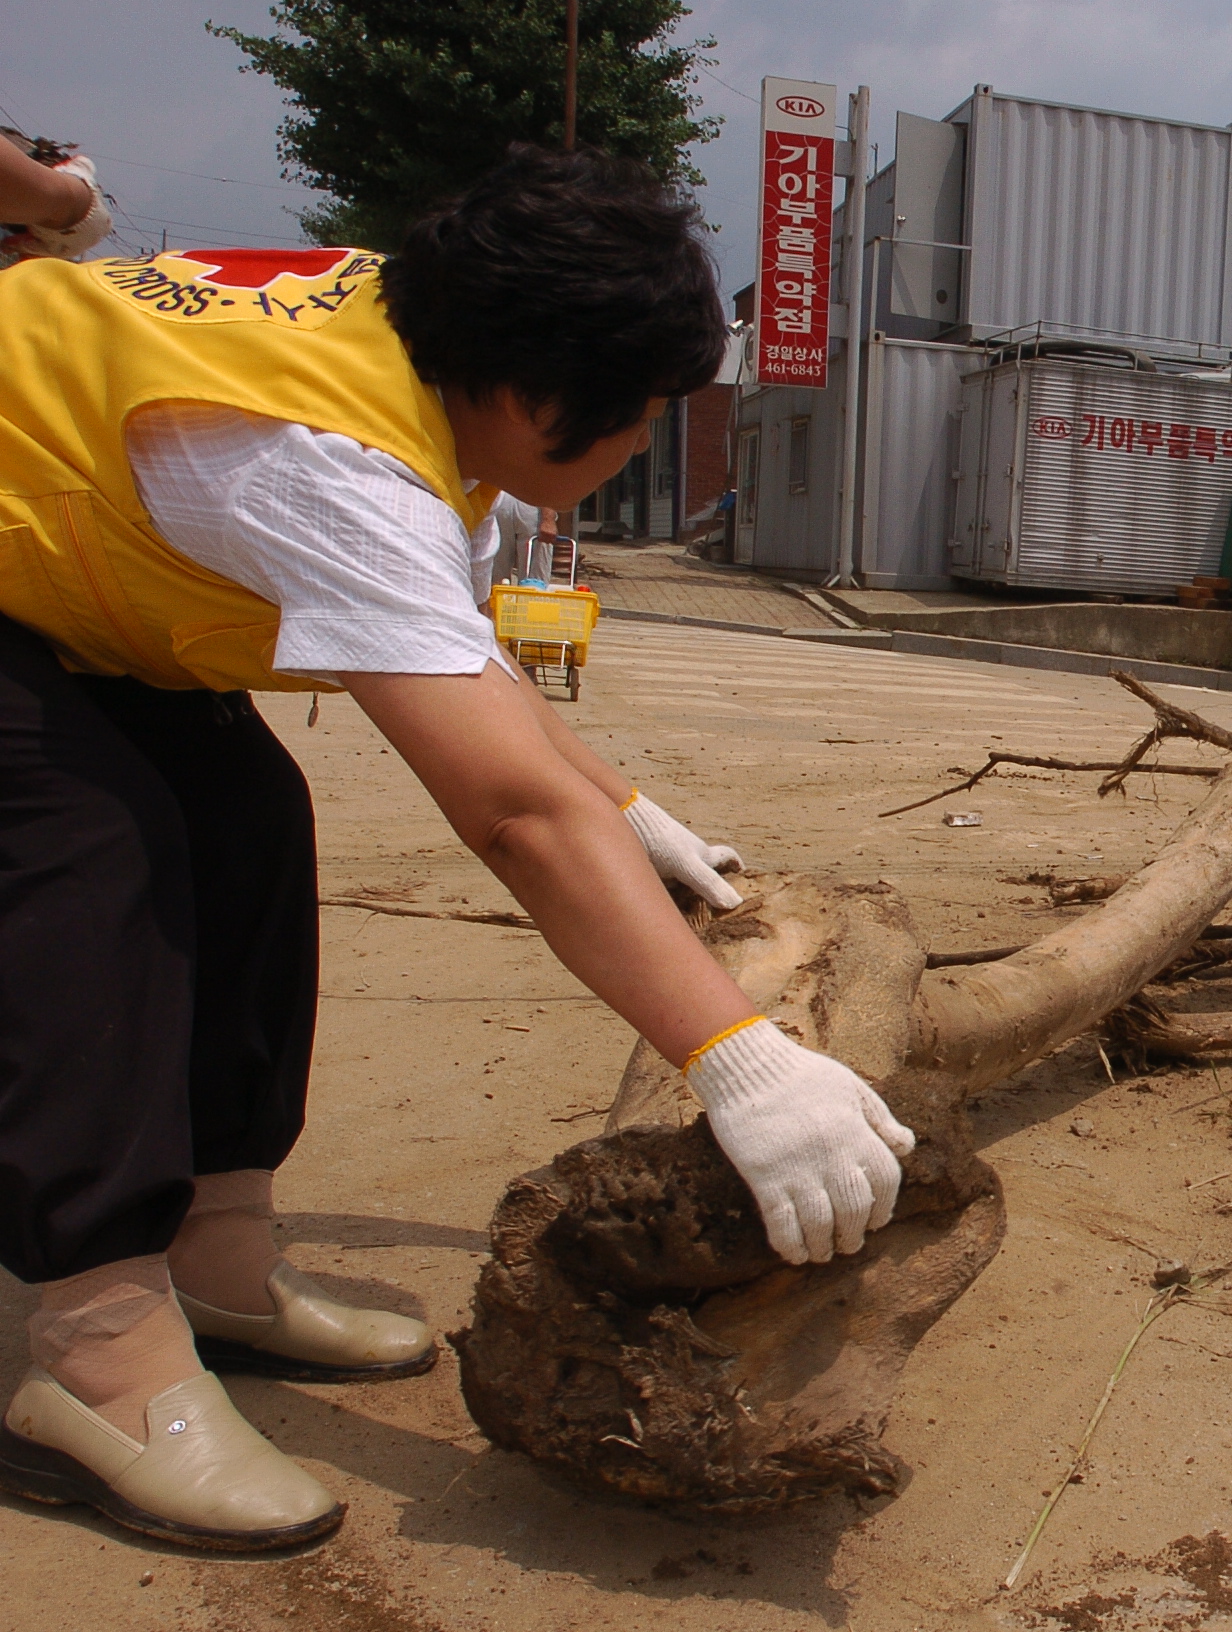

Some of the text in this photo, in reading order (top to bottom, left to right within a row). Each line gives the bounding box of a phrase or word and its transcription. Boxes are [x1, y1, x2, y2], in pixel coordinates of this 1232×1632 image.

[785, 100, 817, 115] KIA
[774, 145, 820, 334] 기아부품특약점
[765, 344, 823, 363] 경일상사
[765, 362, 821, 377] 461-6843
